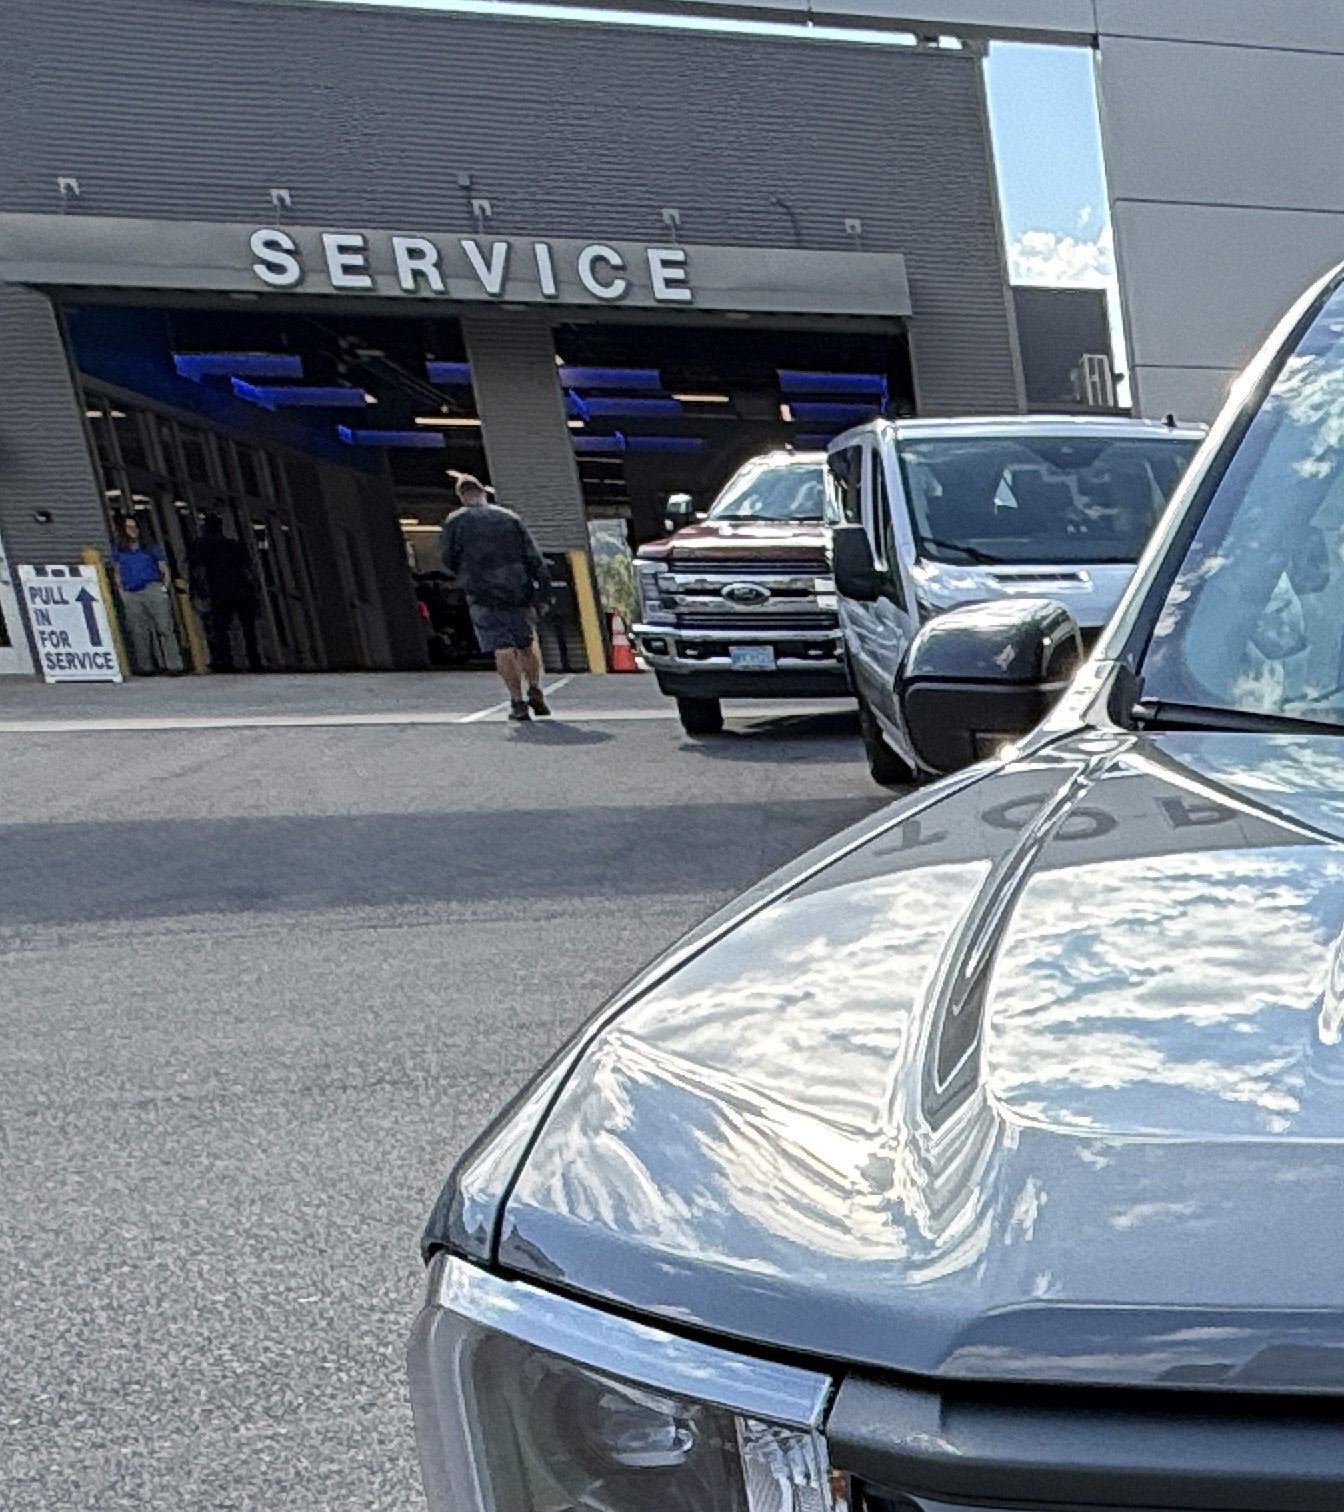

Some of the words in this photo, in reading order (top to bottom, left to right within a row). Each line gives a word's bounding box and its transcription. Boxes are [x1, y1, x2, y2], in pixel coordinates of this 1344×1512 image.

[249, 228, 693, 302] SERVICE
[29, 586, 69, 605] PULL
[33, 608, 52, 626] IN
[38, 630, 71, 648] FOR
[44, 652, 114, 669] SERVICE
